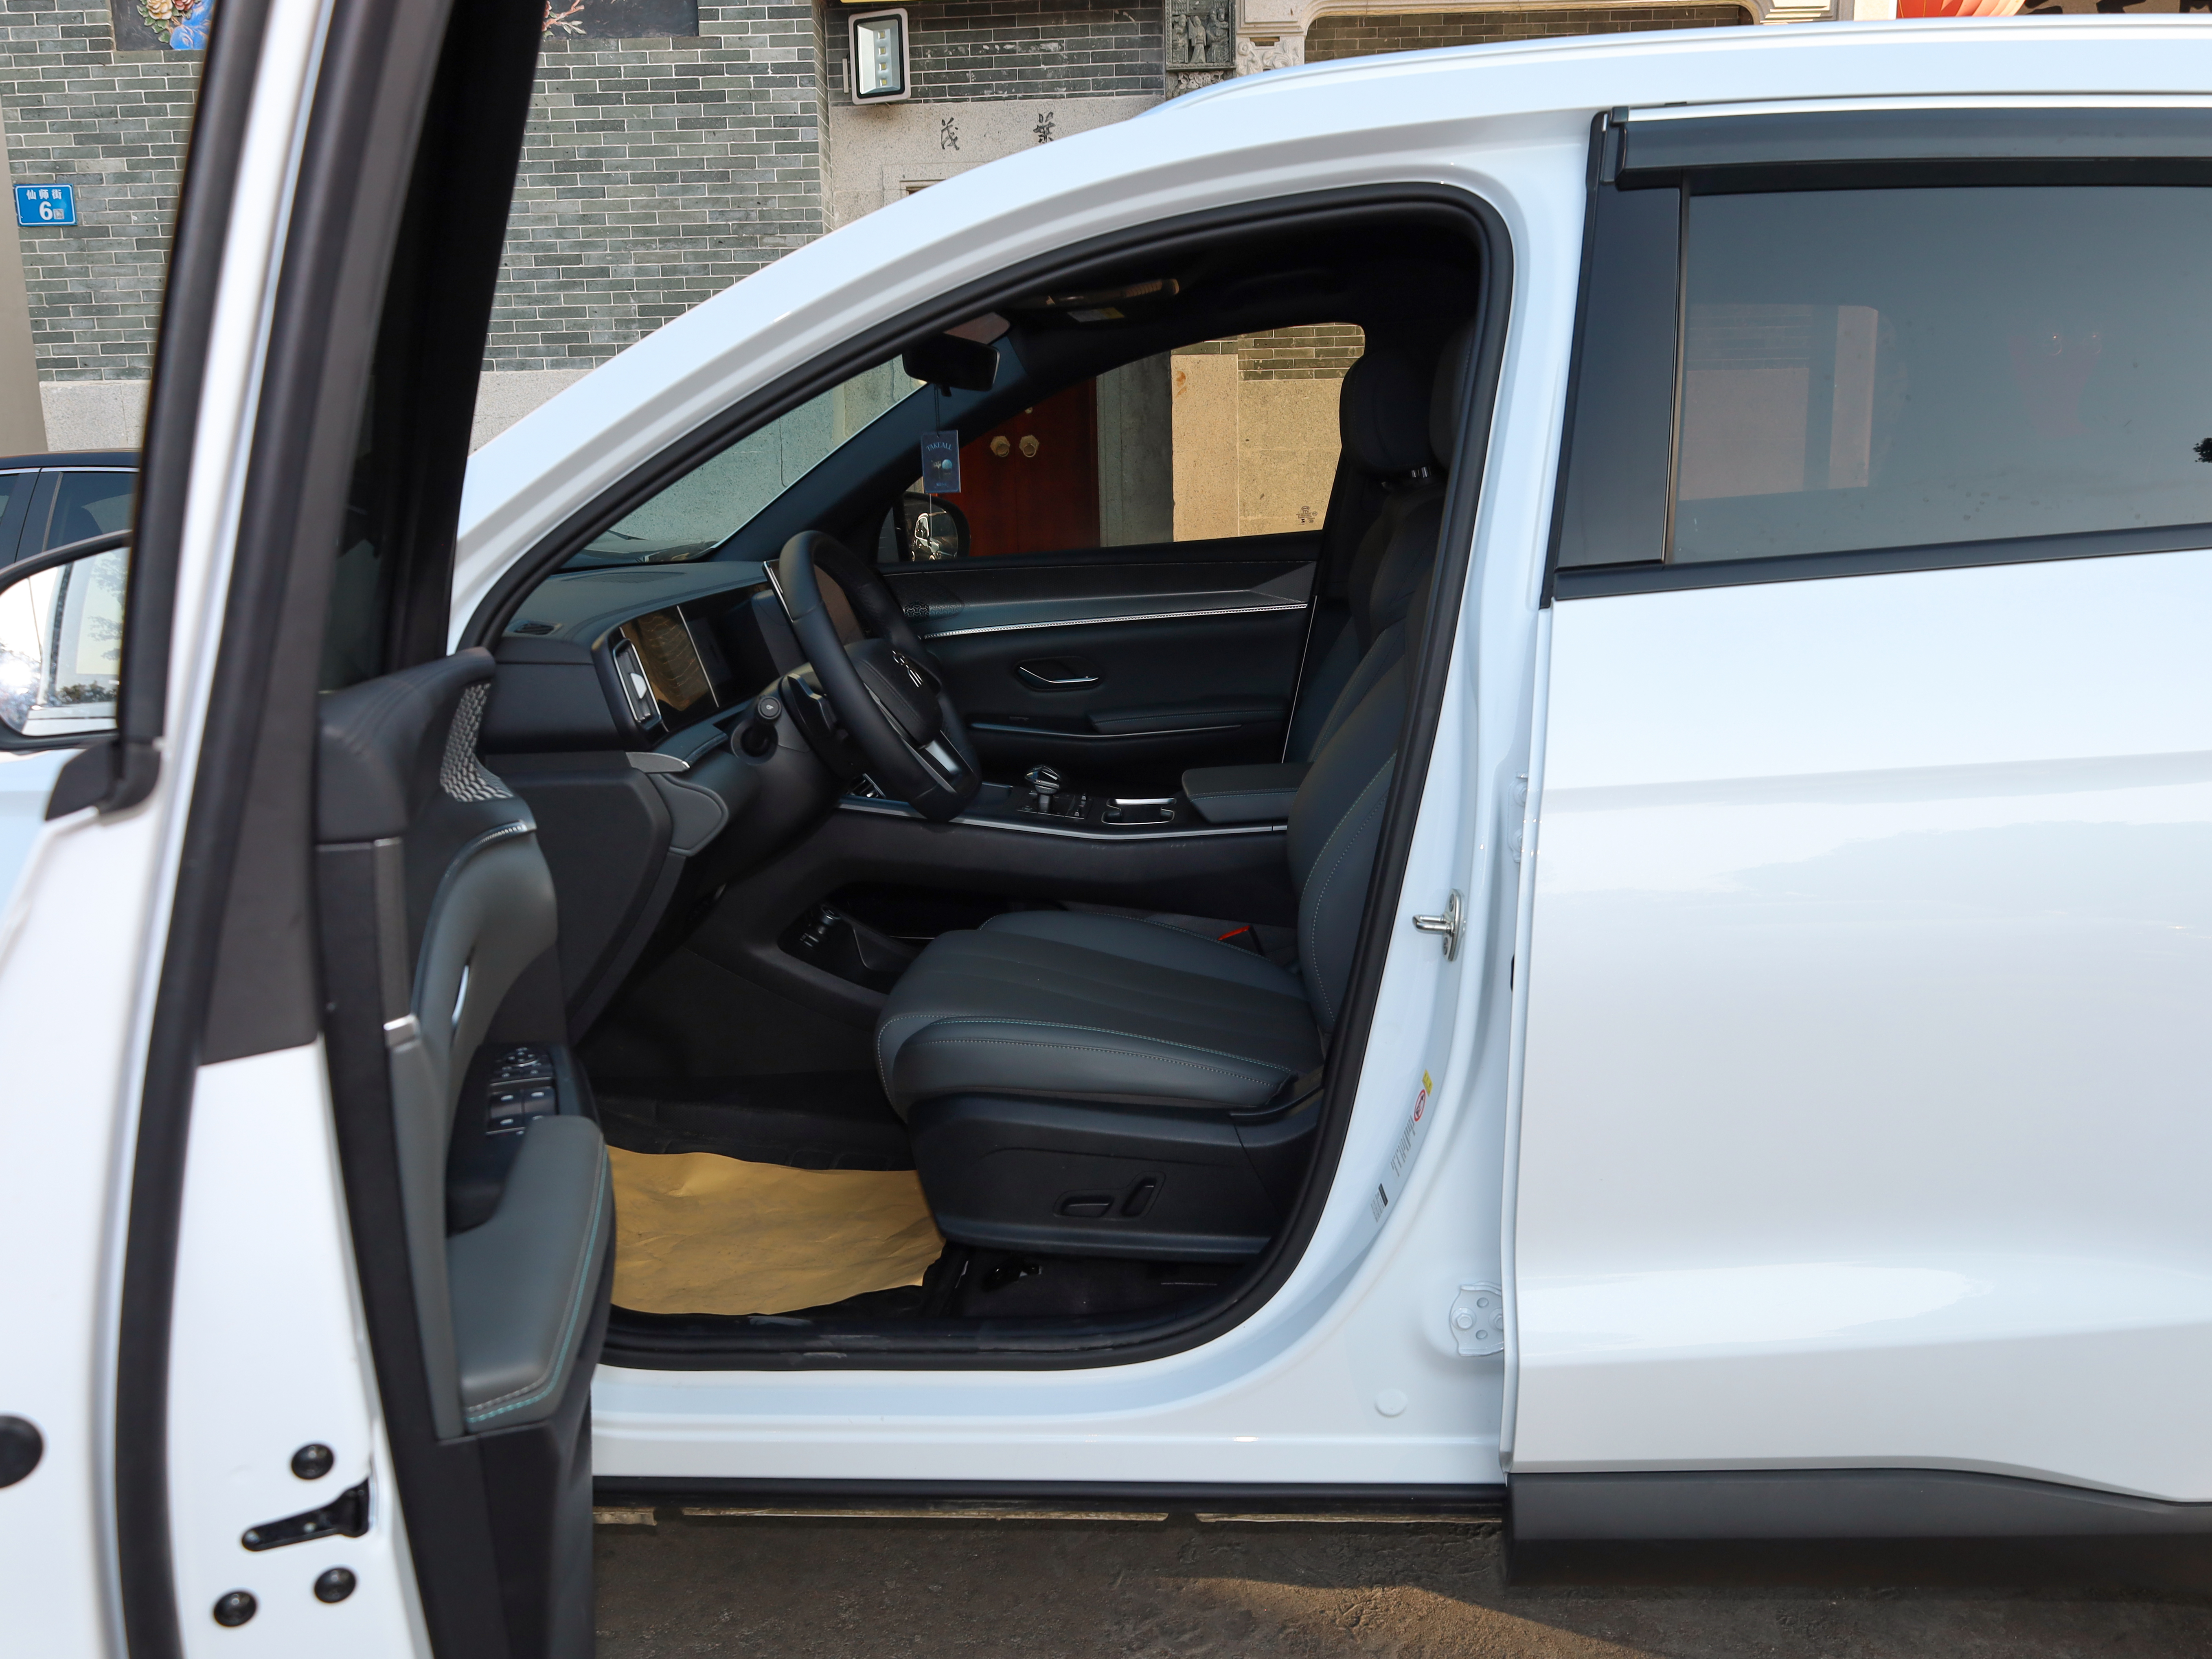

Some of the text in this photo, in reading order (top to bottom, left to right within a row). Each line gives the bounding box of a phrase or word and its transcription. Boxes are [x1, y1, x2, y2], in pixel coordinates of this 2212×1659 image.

[26, 189, 62, 200] 仙师街
[39, 201, 53, 220] 6
